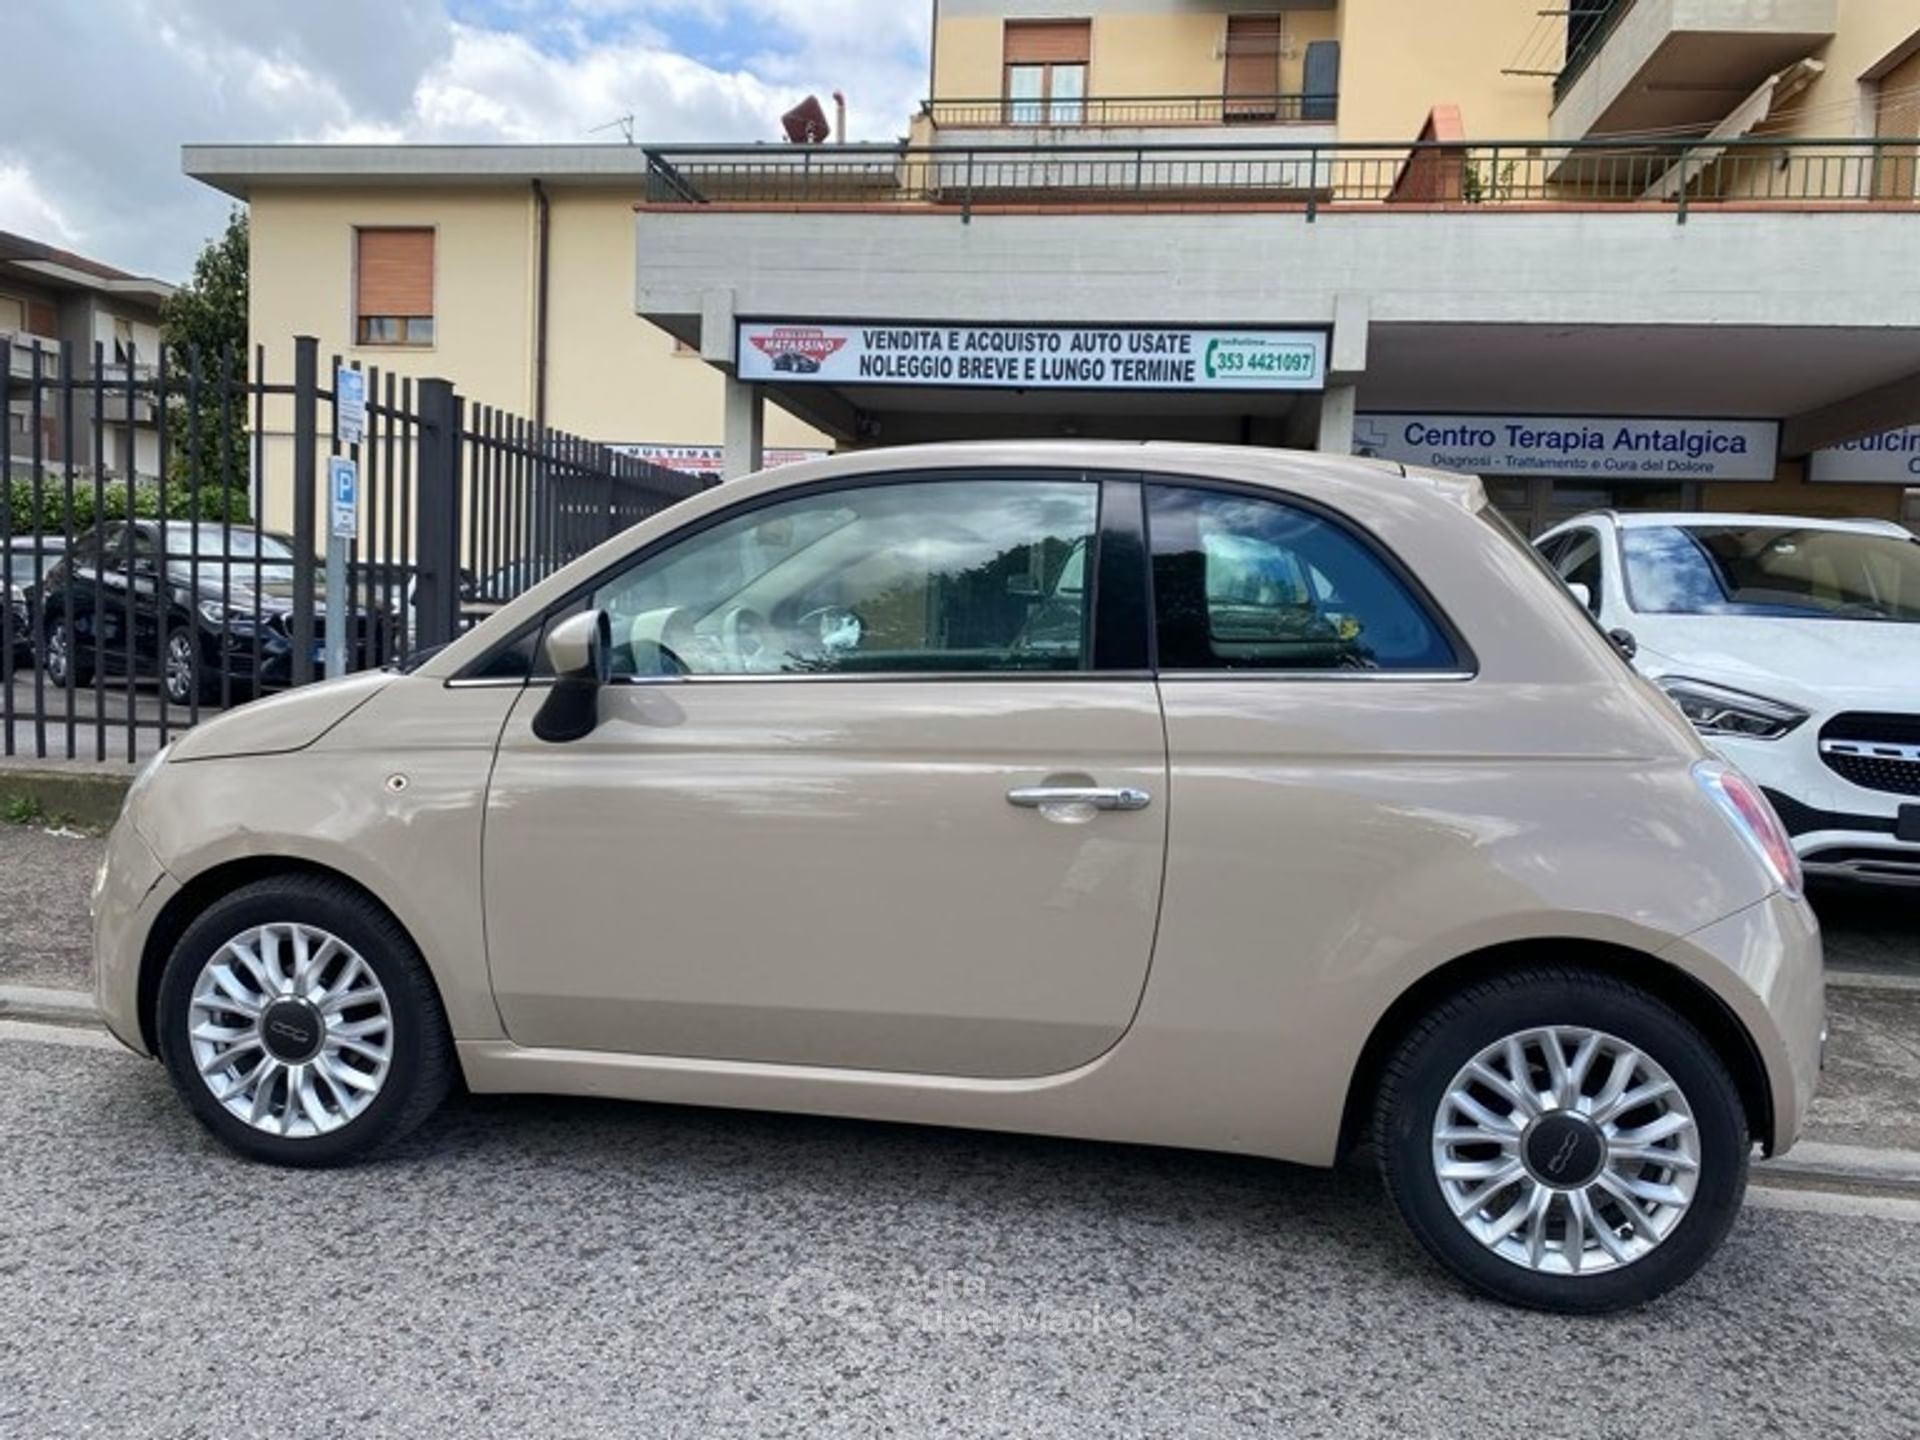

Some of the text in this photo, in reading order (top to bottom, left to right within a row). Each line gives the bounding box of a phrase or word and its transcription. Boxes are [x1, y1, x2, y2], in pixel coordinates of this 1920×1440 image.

[764, 338, 834, 352] MATASSINO
[862, 330, 1191, 354] VENDITA E ACQUISTO AUTO USATE
[859, 354, 1196, 382] NOLEGGIO BREVE E LUNGO TERMINE
[1217, 352, 1311, 371] 353 4421097
[1404, 422, 1748, 458] Centro Terapia Antalgica
[1431, 453, 1491, 468] Diagnosi
[1504, 455, 1588, 470] Trattamento
[1591, 460, 1601, 469] e
[1604, 458, 1638, 471] Cura
[1640, 459, 1663, 471] del
[1667, 460, 1714, 473] Dolore
[340, 471, 352, 500] P
